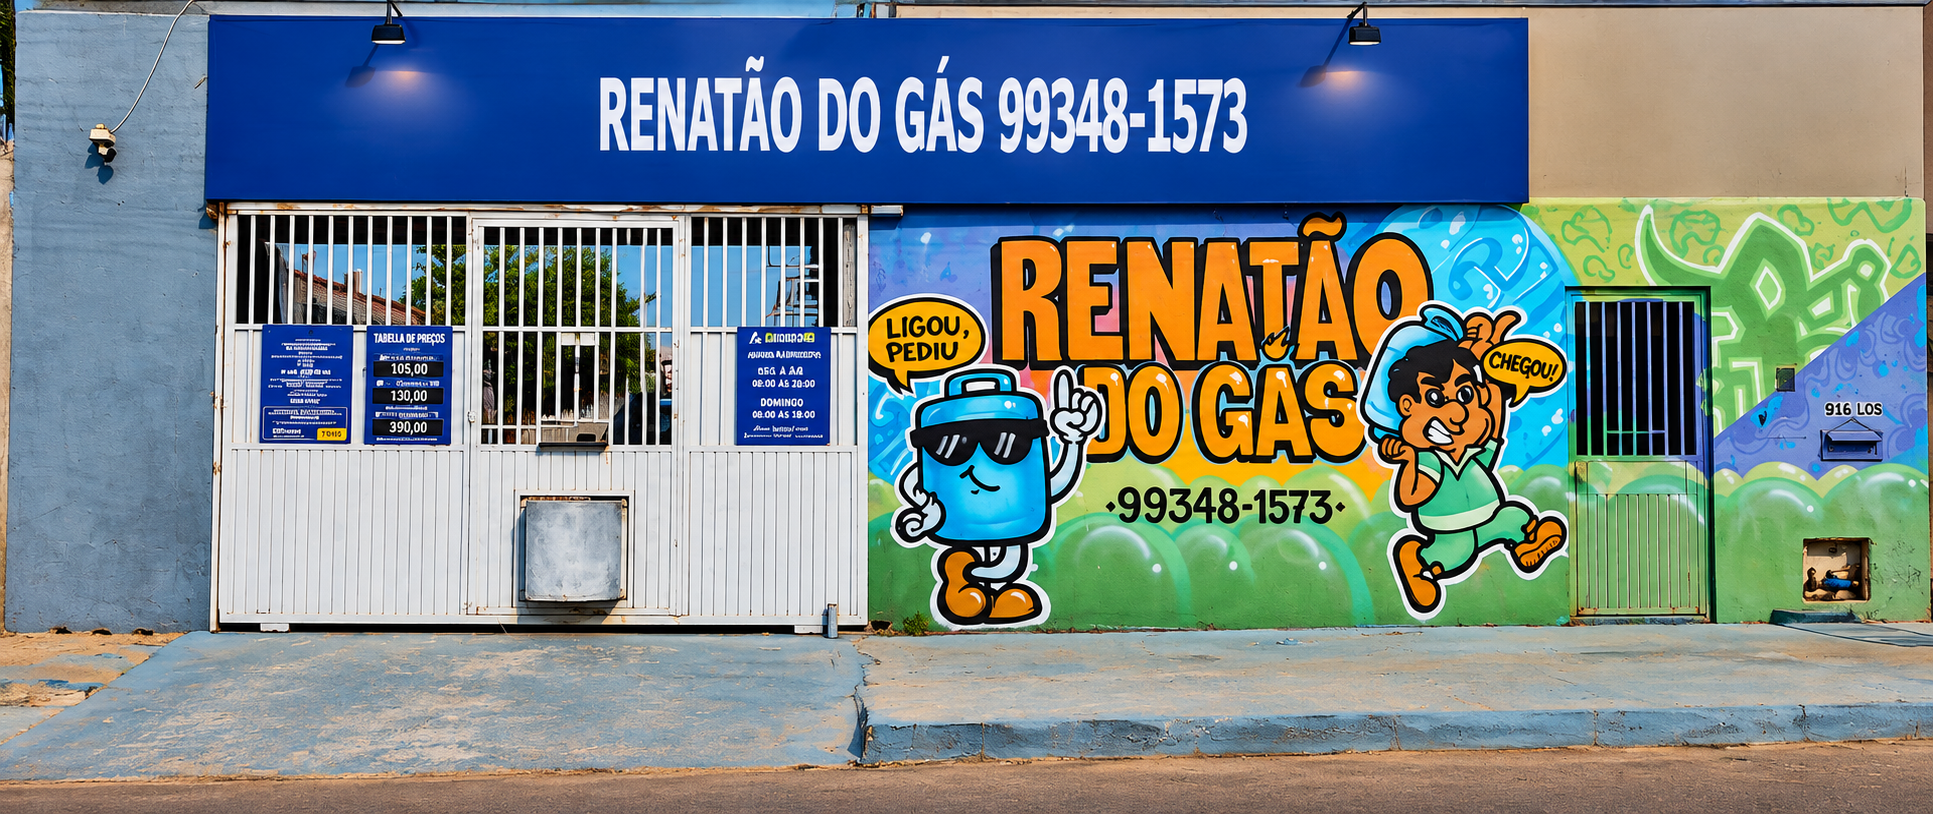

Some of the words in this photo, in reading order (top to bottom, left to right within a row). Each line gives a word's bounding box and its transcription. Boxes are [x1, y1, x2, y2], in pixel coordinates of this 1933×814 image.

[599, 55, 802, 153] RENATÃO
[818, 76, 881, 153] DO
[895, 55, 984, 154] GÁS
[998, 76, 1248, 154] 99348-1573
[990, 211, 1434, 371] RENATÃO
[885, 315, 970, 340] LIGOU,
[406, 333, 415, 344] DE
[885, 341, 959, 363] PEDIU
[391, 362, 428, 377] 105,00
[1488, 351, 1559, 382] CHEGOU!
[390, 389, 428, 404] 130,00
[760, 398, 804, 408] DOMINGO
[1076, 361, 1184, 464] DO
[1824, 402, 1852, 416] 916
[1856, 402, 1883, 416] LOS
[389, 420, 428, 436] 390,00
